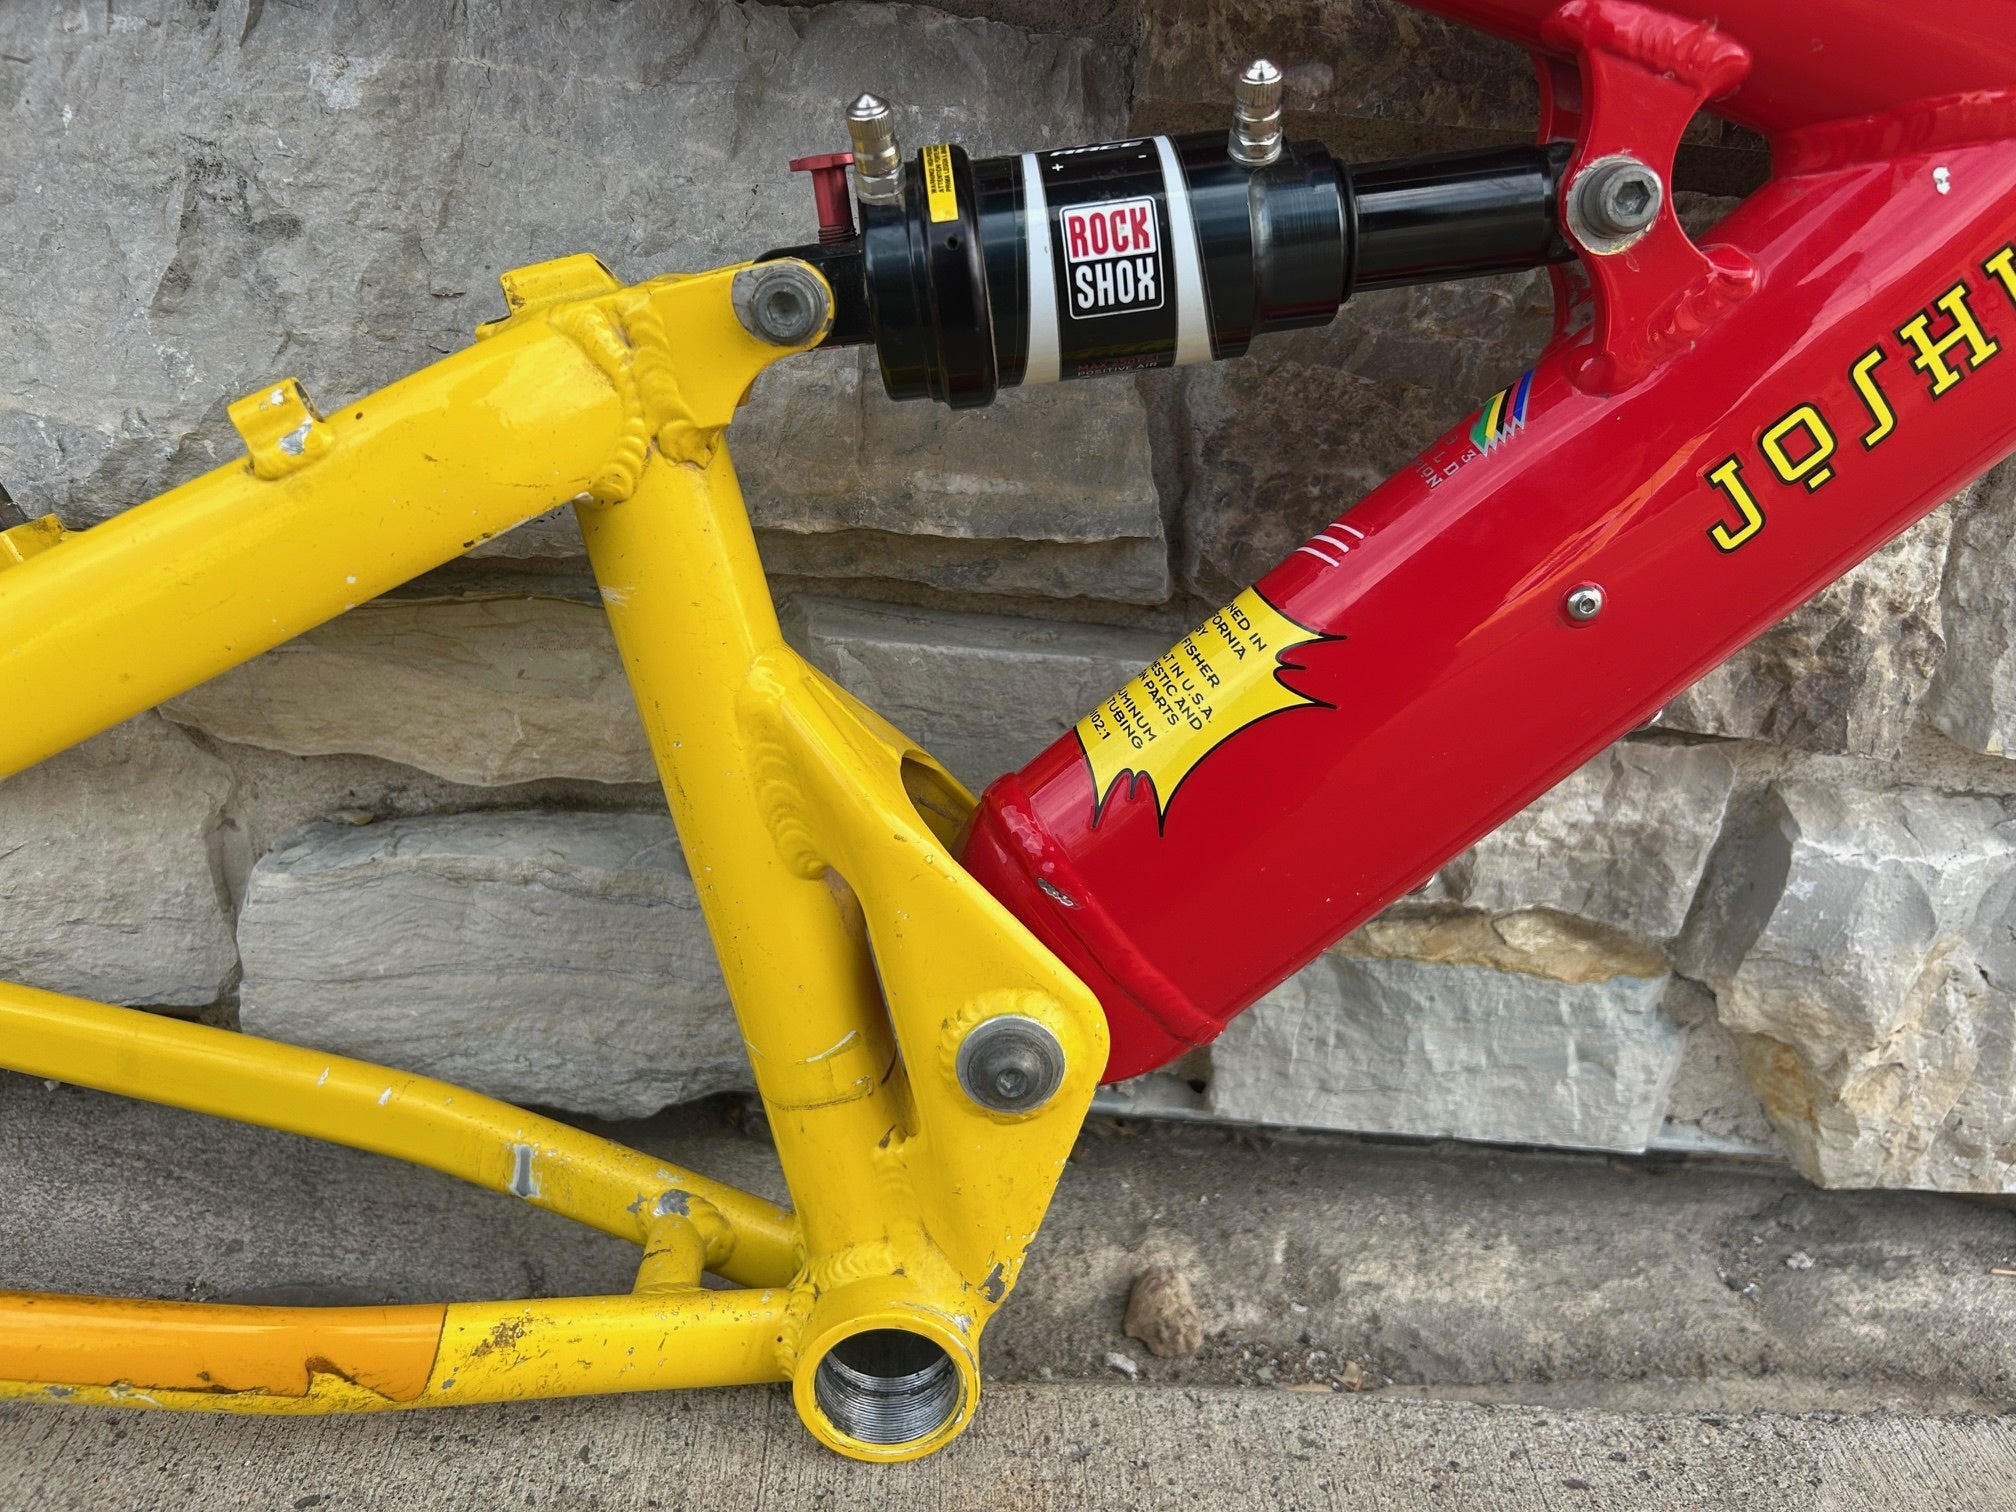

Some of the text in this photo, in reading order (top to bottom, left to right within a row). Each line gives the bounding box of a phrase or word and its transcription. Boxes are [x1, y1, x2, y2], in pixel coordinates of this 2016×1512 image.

[1068, 205, 1152, 258] ROCK
[1076, 255, 1156, 310] SHOX
[1705, 241, 2016, 554] JOSH
[1181, 637, 1220, 688] FISHER
[1249, 633, 1267, 652] IN
[1143, 680, 1180, 726] PARTS
[1151, 660, 1203, 730] ESTIC AND
[1169, 662, 1185, 679] IN
[1182, 678, 1213, 723] U.S.A.
[1107, 697, 1143, 749] TUBING
